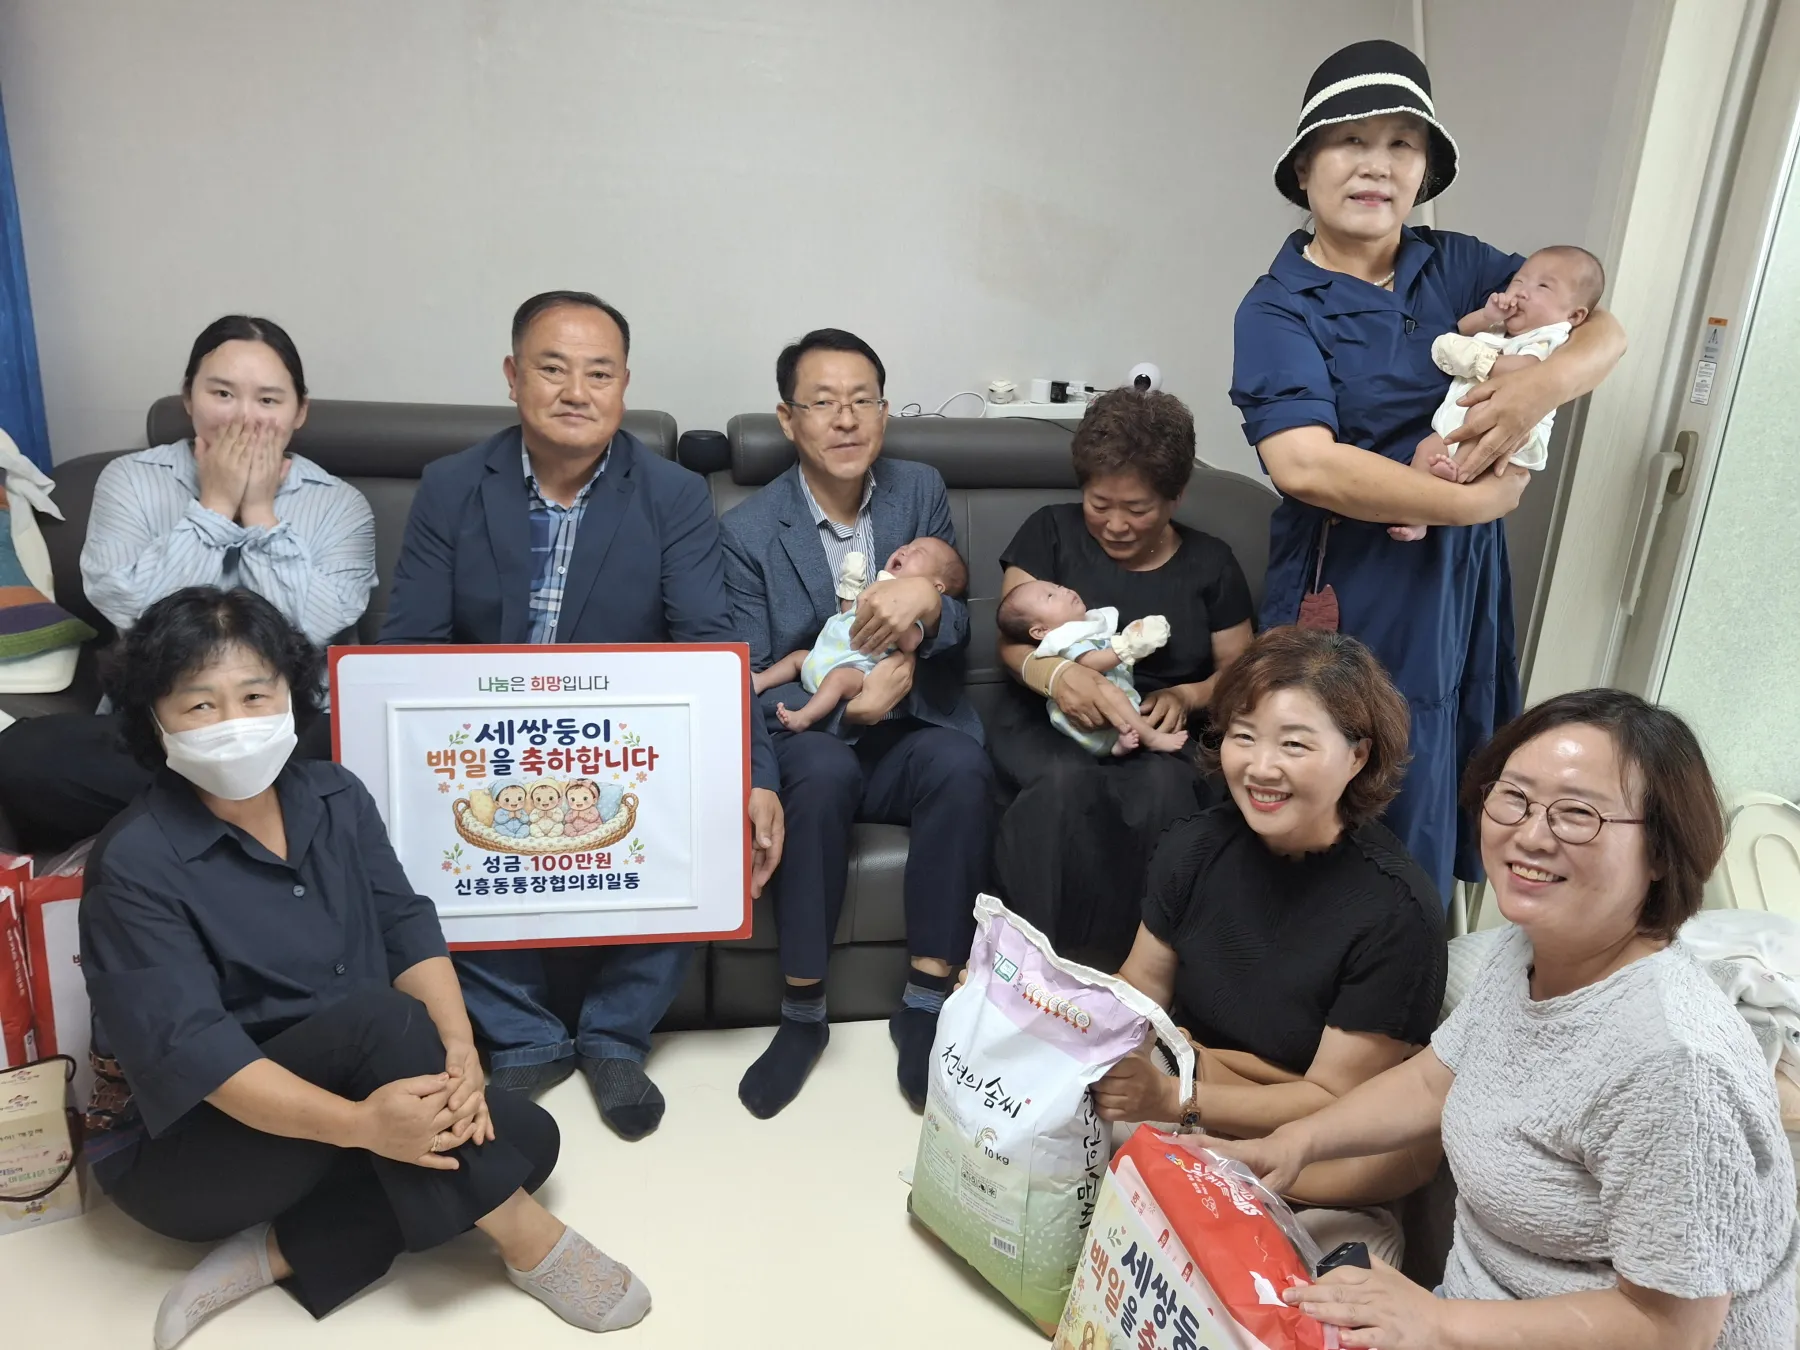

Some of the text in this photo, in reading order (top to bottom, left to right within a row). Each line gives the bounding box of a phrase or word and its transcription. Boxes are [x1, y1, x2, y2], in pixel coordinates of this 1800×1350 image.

[478, 675, 609, 692] 나눔은 희망입니다
[474, 719, 611, 746] 세쌍둥이
[426, 746, 659, 780] 백일을 축하합니다
[482, 853, 612, 873] 성금 100만원
[454, 872, 640, 896] 신흥동통장협의회일동
[941, 1042, 984, 1092] 천년의
[984, 1076, 1022, 1119] 솜씨
[984, 1146, 1010, 1166] 10 kg
[1090, 1238, 1138, 1339] 백일을
[1121, 1241, 1209, 1350] 세쌍둥
